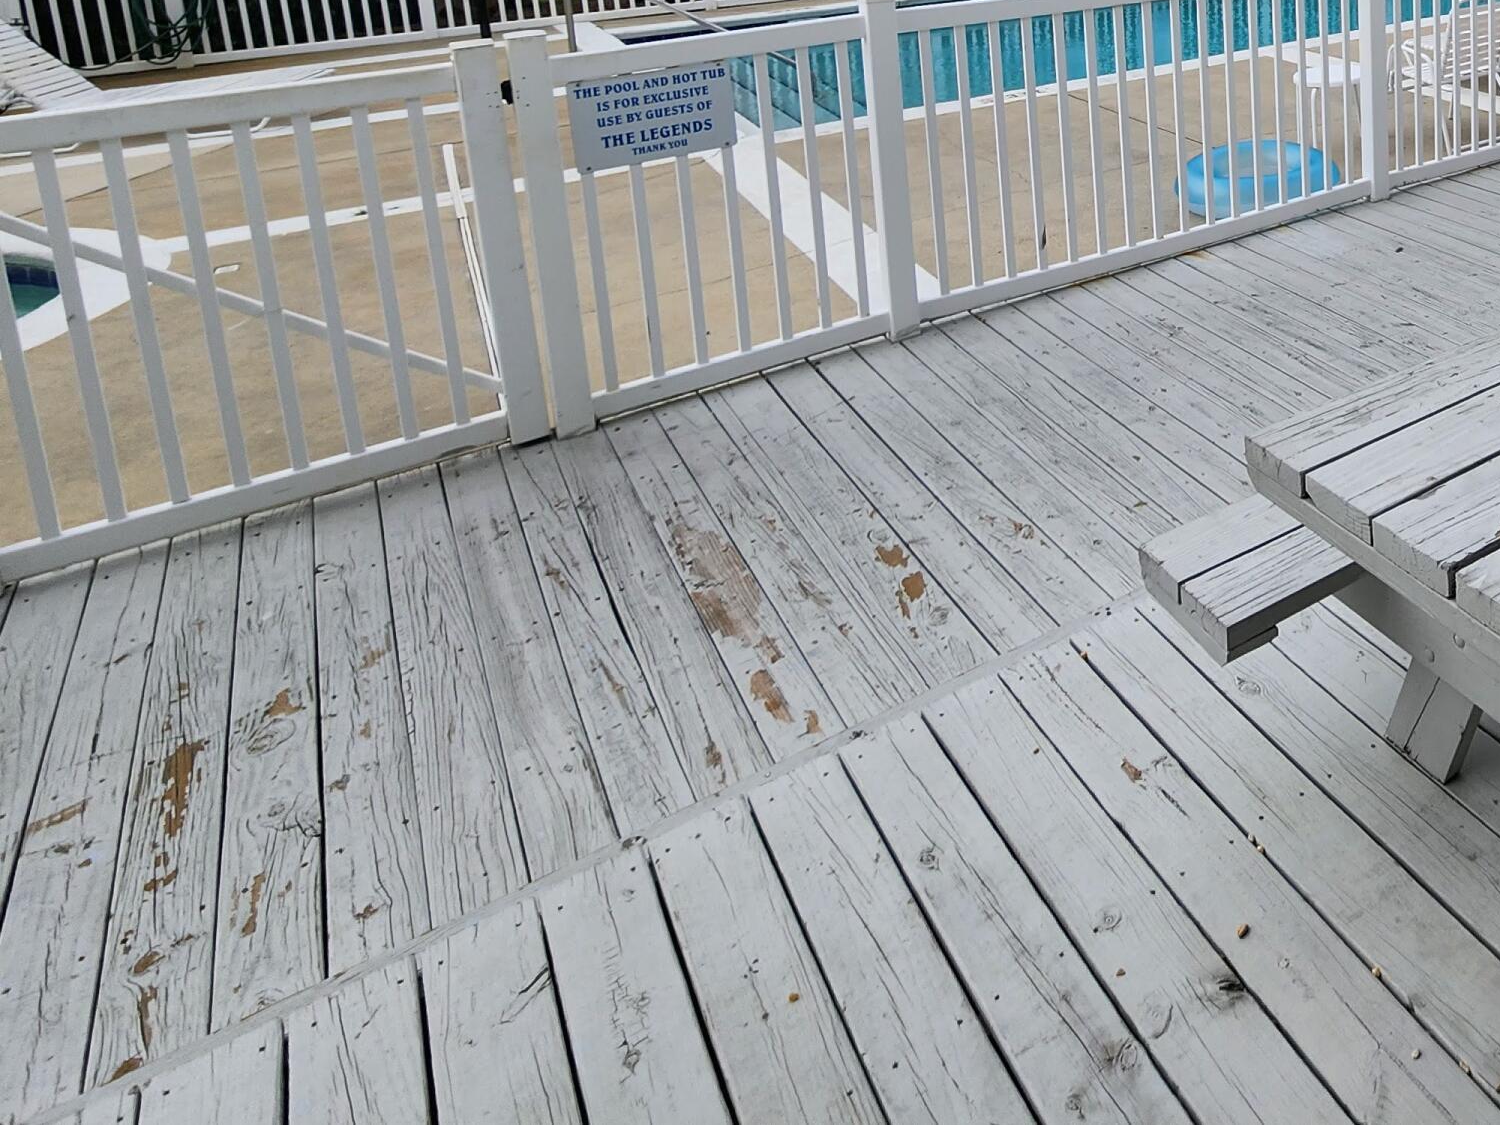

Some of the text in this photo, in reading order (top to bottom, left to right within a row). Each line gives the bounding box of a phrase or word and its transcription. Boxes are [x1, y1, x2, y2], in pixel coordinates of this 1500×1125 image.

[573, 68, 725, 100] THE POOL AND HOT TUB
[596, 85, 709, 112] IS FOR EXCLUSIVE
[597, 100, 712, 128] USE BY GUESTS OF
[601, 118, 713, 149] THE LEGENDS
[632, 138, 688, 155] THANK YOU
